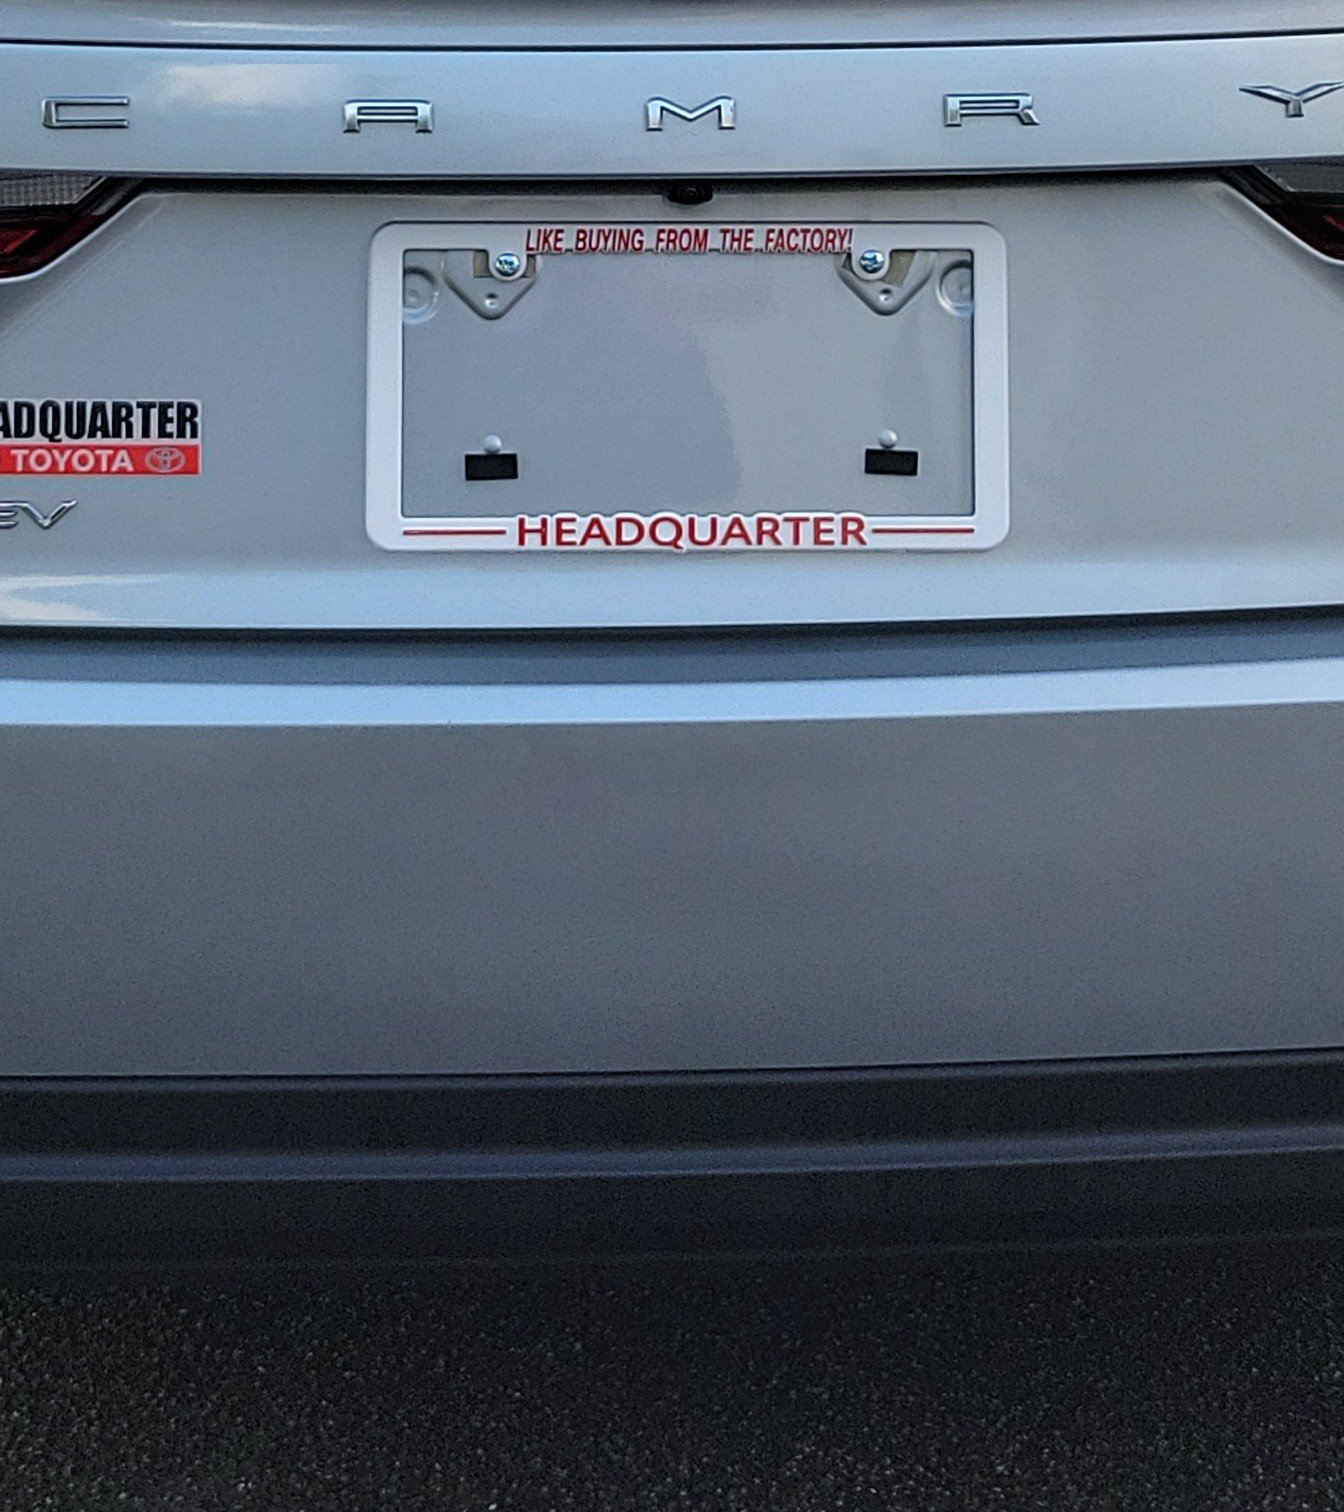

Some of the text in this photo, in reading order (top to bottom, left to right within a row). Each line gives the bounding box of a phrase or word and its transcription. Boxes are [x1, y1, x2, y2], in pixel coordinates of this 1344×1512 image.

[524, 228, 854, 252] LIKE BUYING FROM THE FACTORY!
[9, 448, 135, 473] TOYOTA
[517, 515, 868, 550] HEADQUARTER
